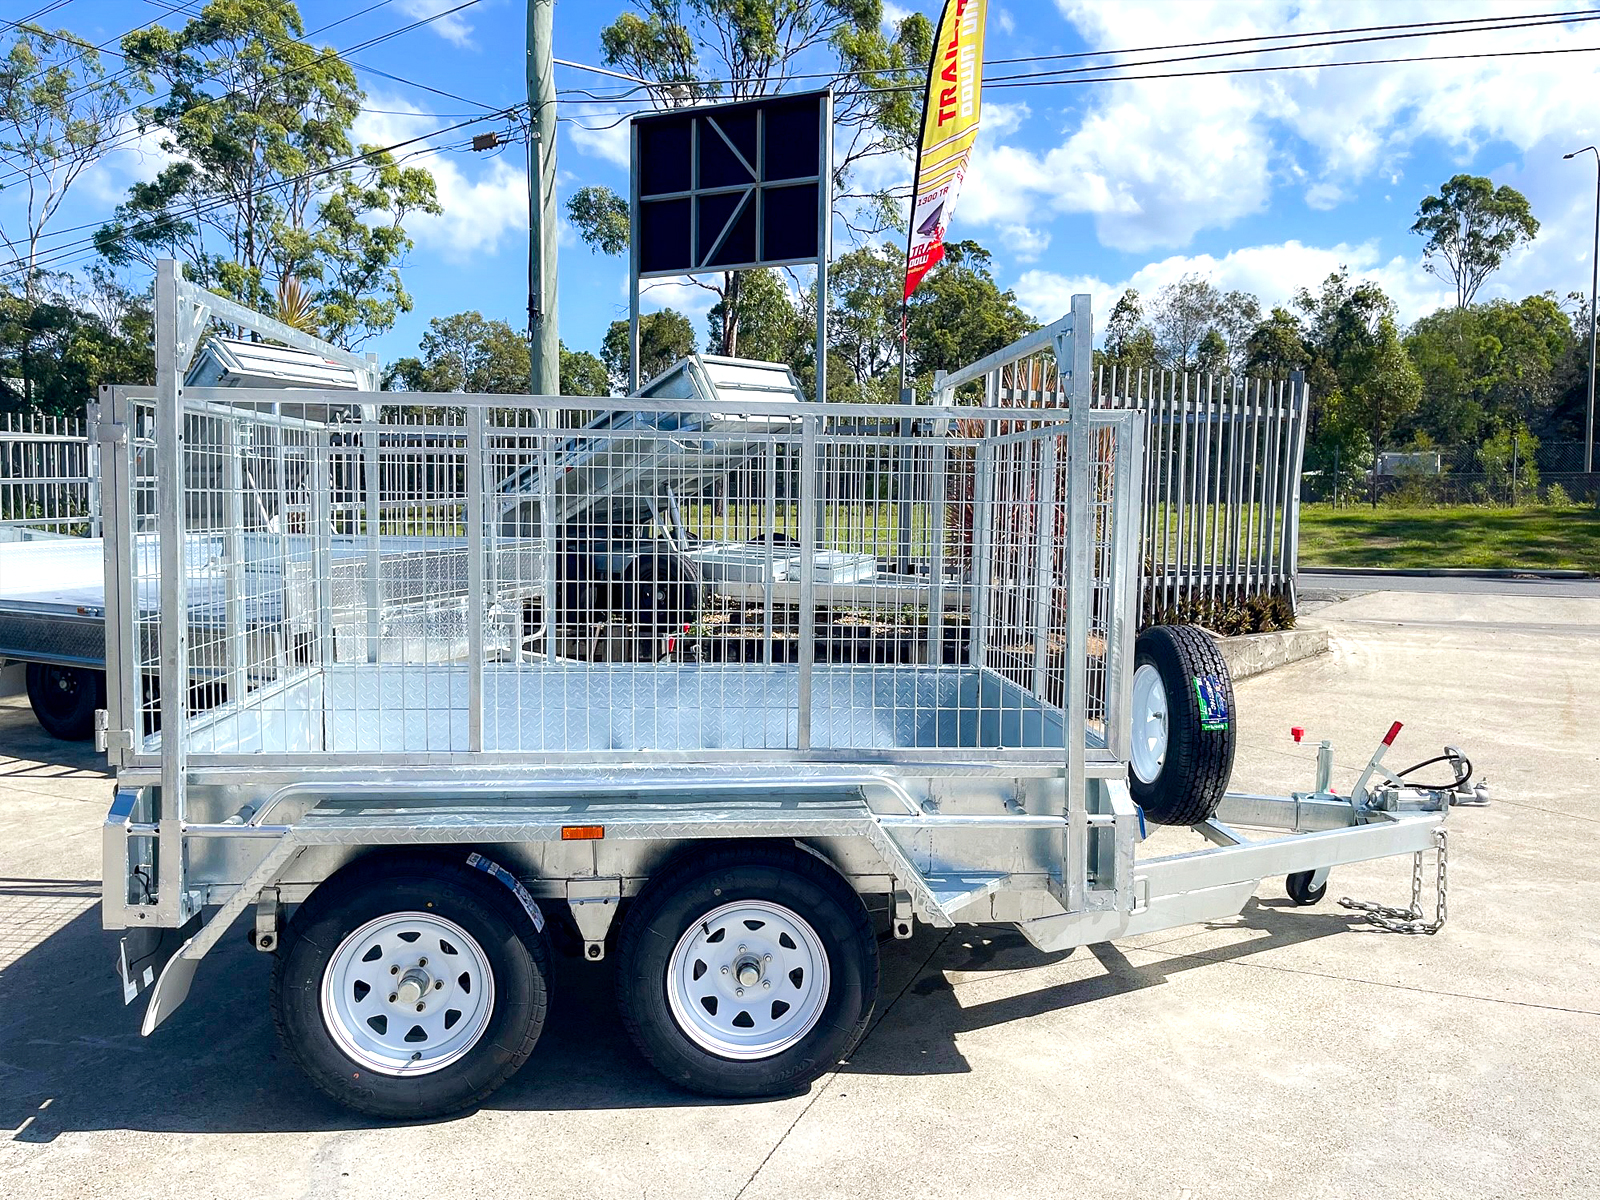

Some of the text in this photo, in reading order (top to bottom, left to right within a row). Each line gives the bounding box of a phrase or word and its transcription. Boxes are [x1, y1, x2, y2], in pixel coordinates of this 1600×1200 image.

[960, 0, 979, 118] DOWN UN
[917, 191, 938, 207] 1300
